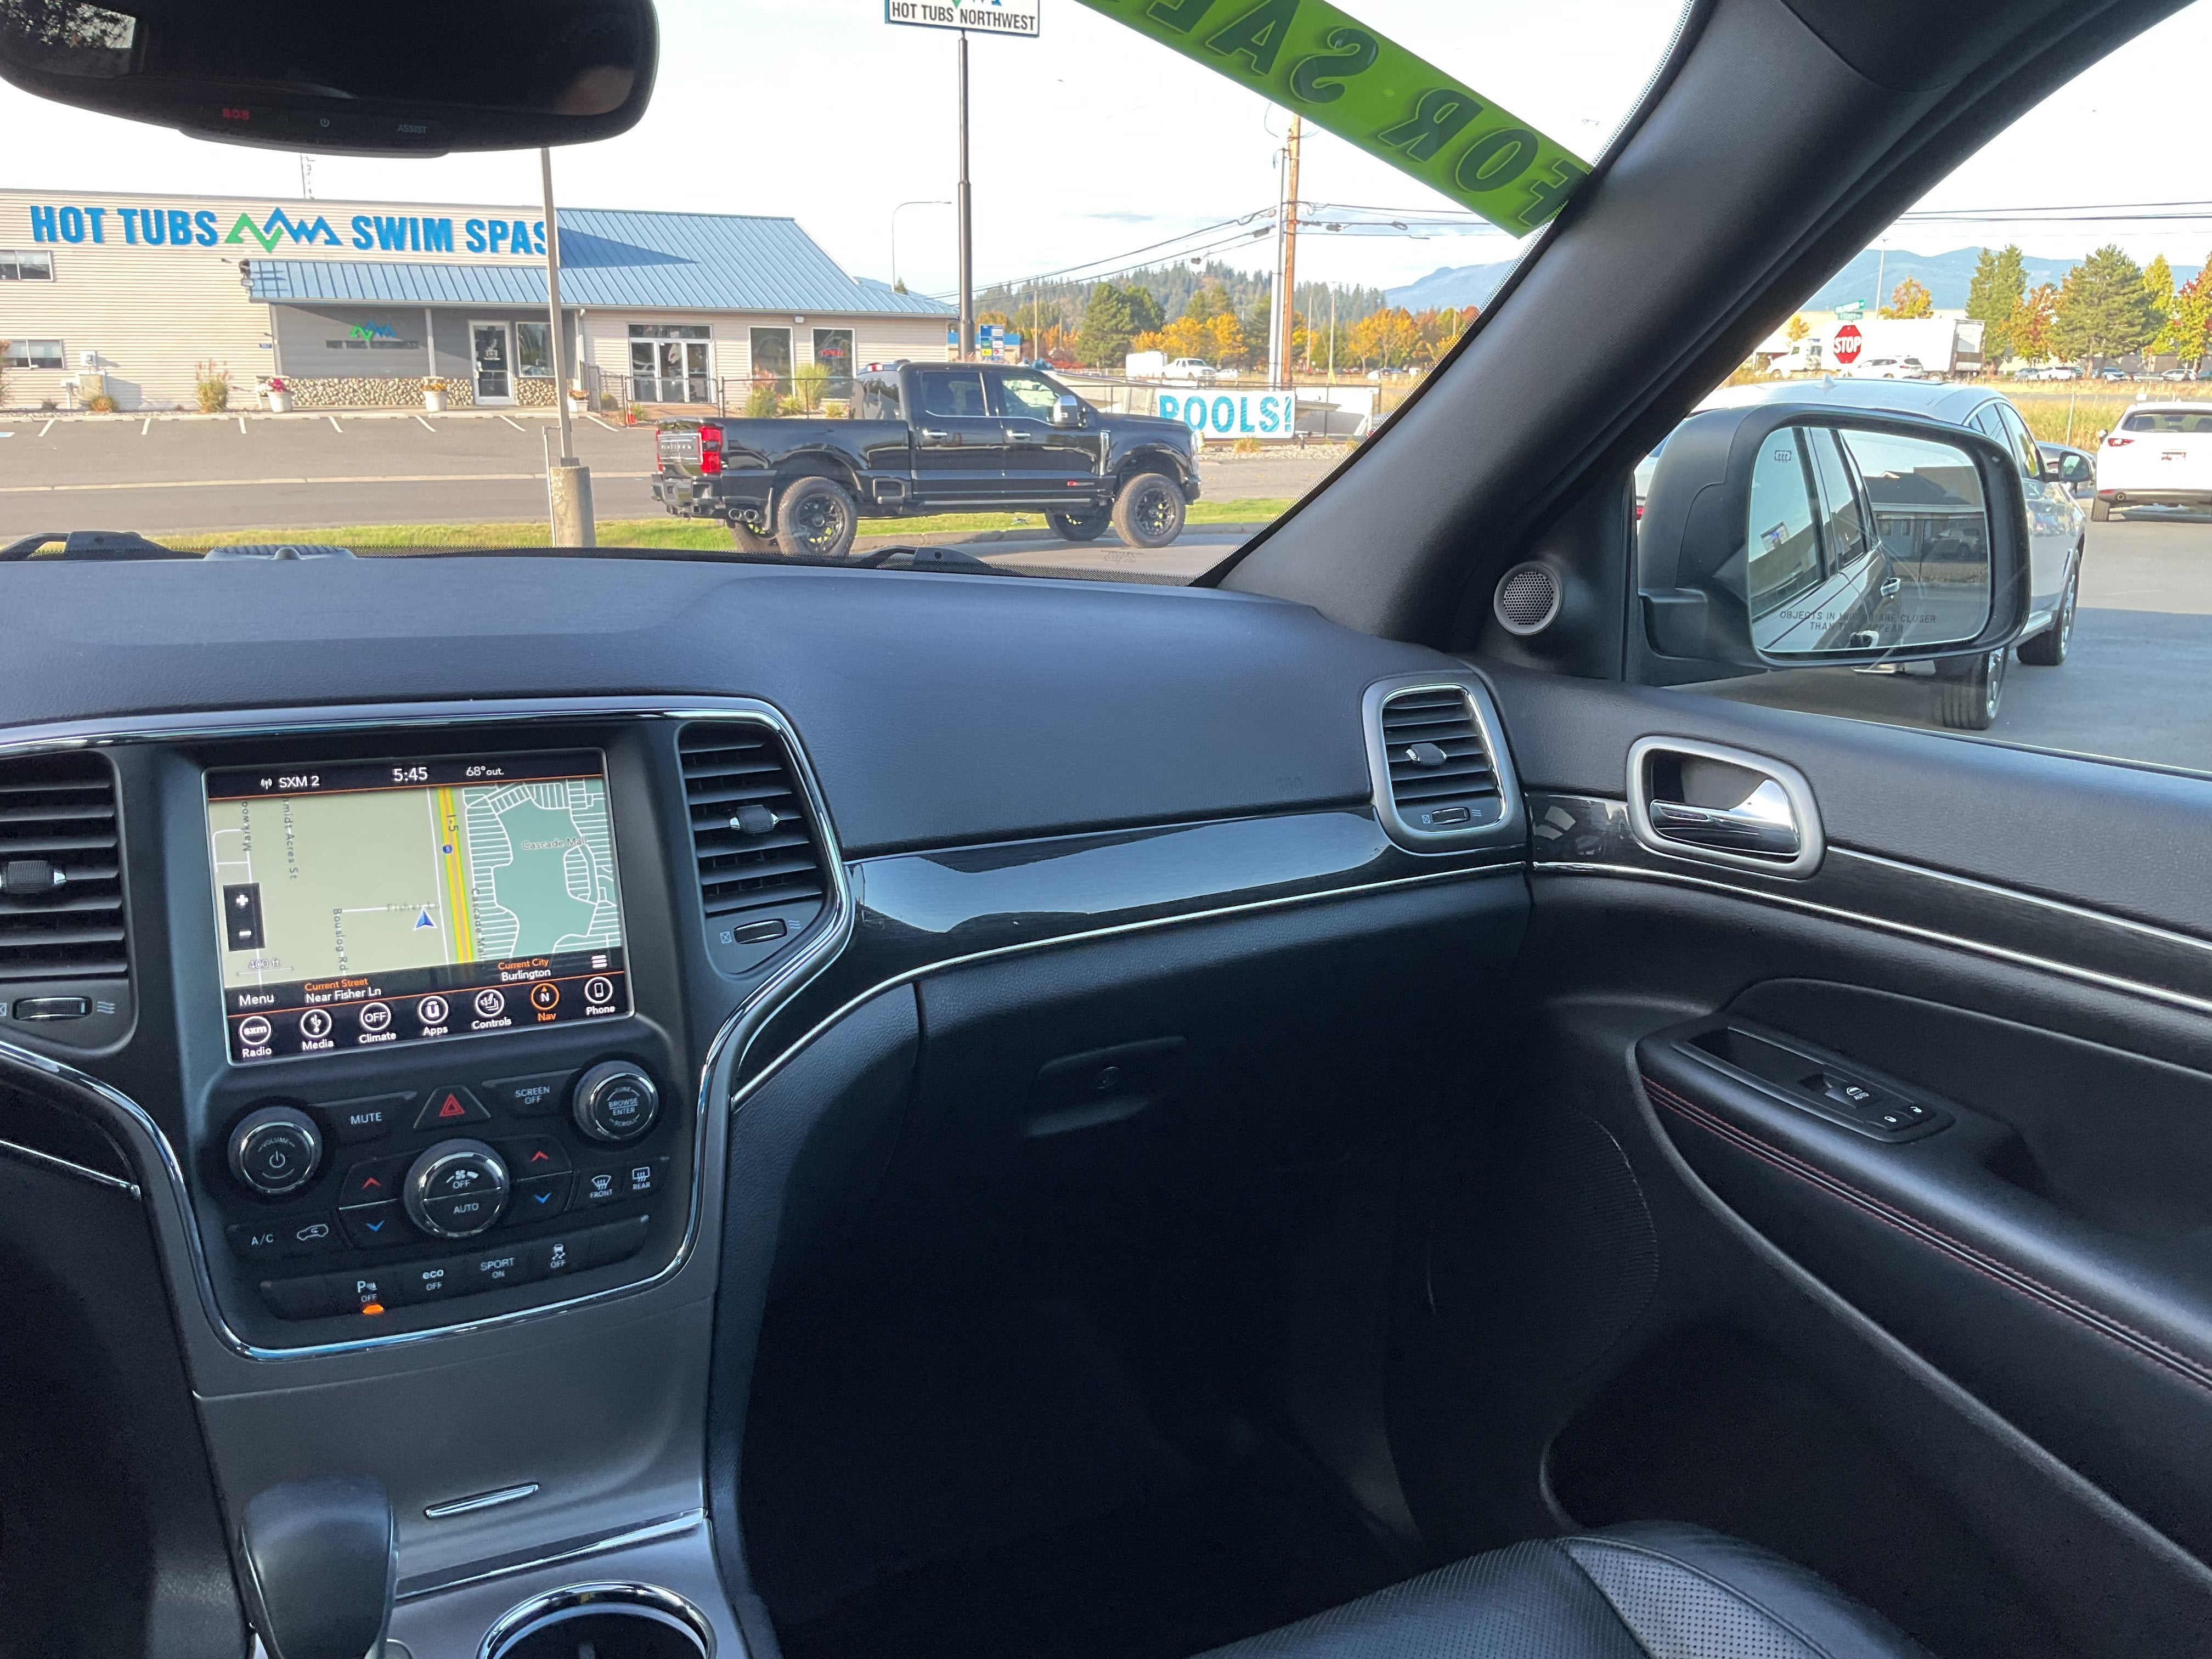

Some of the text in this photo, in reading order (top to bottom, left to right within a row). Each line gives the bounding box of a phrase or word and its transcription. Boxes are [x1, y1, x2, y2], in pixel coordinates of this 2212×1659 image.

[892, 2, 1036, 31] HOT TUBS NORTHWEST
[397, 124, 427, 134] ASSIST
[30, 205, 546, 255] HOT TUBS SWIM SPAS
[1833, 336, 1862, 354] STOP
[1159, 395, 1291, 432] POOLS!
[1780, 611, 1936, 624] OBJECTS IN MIRR ARE CLOSER
[1810, 622, 1835, 631] THAN
[1837, 622, 1863, 631] THE
[394, 766, 428, 782] 5:45
[279, 775, 320, 788] SXM 2
[446, 814, 459, 832] I-5
[286, 833, 295, 863] Acres
[522, 836, 588, 850] Cascade Mall
[289, 867, 298, 879] St
[387, 902, 422, 912] Fisher
[472, 888, 482, 933] Cascade
[333, 907, 349, 971] Bouslog Rd
[248, 958, 281, 970] 400 ft
[498, 958, 549, 970] Current City
[501, 968, 551, 981] Burlington
[304, 978, 368, 992] Current Street
[239, 994, 275, 1006] Menu
[305, 987, 382, 1003] Near Fisher Ln
[585, 1005, 616, 1015] Phone
[365, 1011, 387, 1023] OFF
[537, 1012, 556, 1022] Nav
[472, 1017, 512, 1030] Controls
[244, 1025, 267, 1036] sxm
[422, 1025, 449, 1036] Apps
[358, 1031, 397, 1043] Climate
[302, 1039, 335, 1051] Media
[242, 1047, 273, 1058] Radio
[515, 1086, 550, 1098] SCREEN
[1854, 1092, 1870, 1101] AUTO
[524, 1096, 542, 1105] OFF
[608, 1098, 639, 1108] BROWSE
[612, 1107, 636, 1116] ENTER
[351, 1112, 382, 1125] MUTE
[613, 1118, 636, 1126] SCROLL
[262, 1137, 291, 1148] VOLUME
[452, 1180, 471, 1189] OFF
[632, 1182, 651, 1190] REAR
[590, 1189, 613, 1199] FRONT
[453, 1202, 479, 1215] AUTO
[251, 1234, 274, 1246] A/C
[480, 1257, 516, 1272] SPORT
[550, 1259, 567, 1269] OFF
[422, 1268, 444, 1280] eco
[492, 1269, 506, 1279] ON
[426, 1281, 443, 1291] OFF
[360, 1293, 377, 1304] OFF
